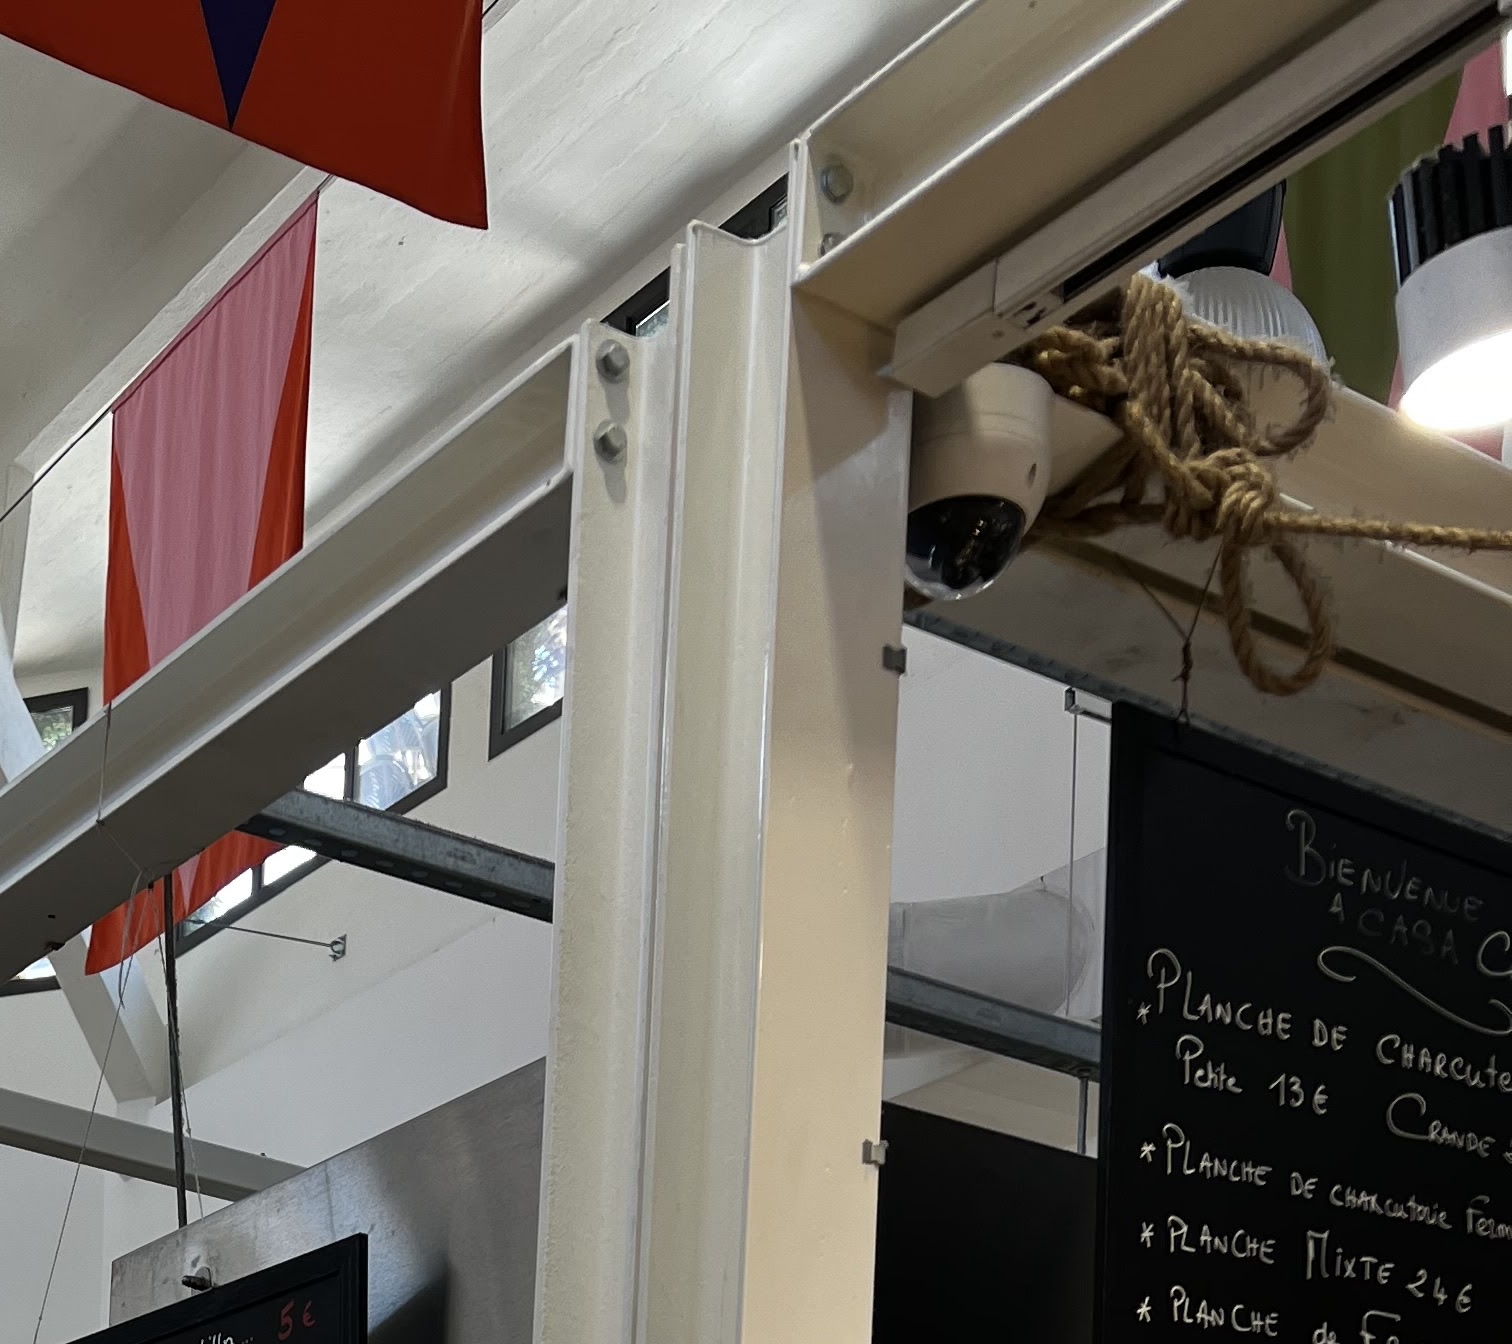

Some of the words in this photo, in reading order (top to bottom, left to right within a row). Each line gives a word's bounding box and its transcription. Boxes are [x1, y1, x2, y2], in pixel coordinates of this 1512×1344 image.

[1147, 948, 1292, 1040] PLANCHE
[1312, 1018, 1348, 1051] DE
[1162, 1122, 1273, 1186] PLANCHE
[1289, 1171, 1319, 1199] DE
[1167, 1215, 1276, 1265] PLANCHE
[1170, 1285, 1279, 1337] PLANCHE
